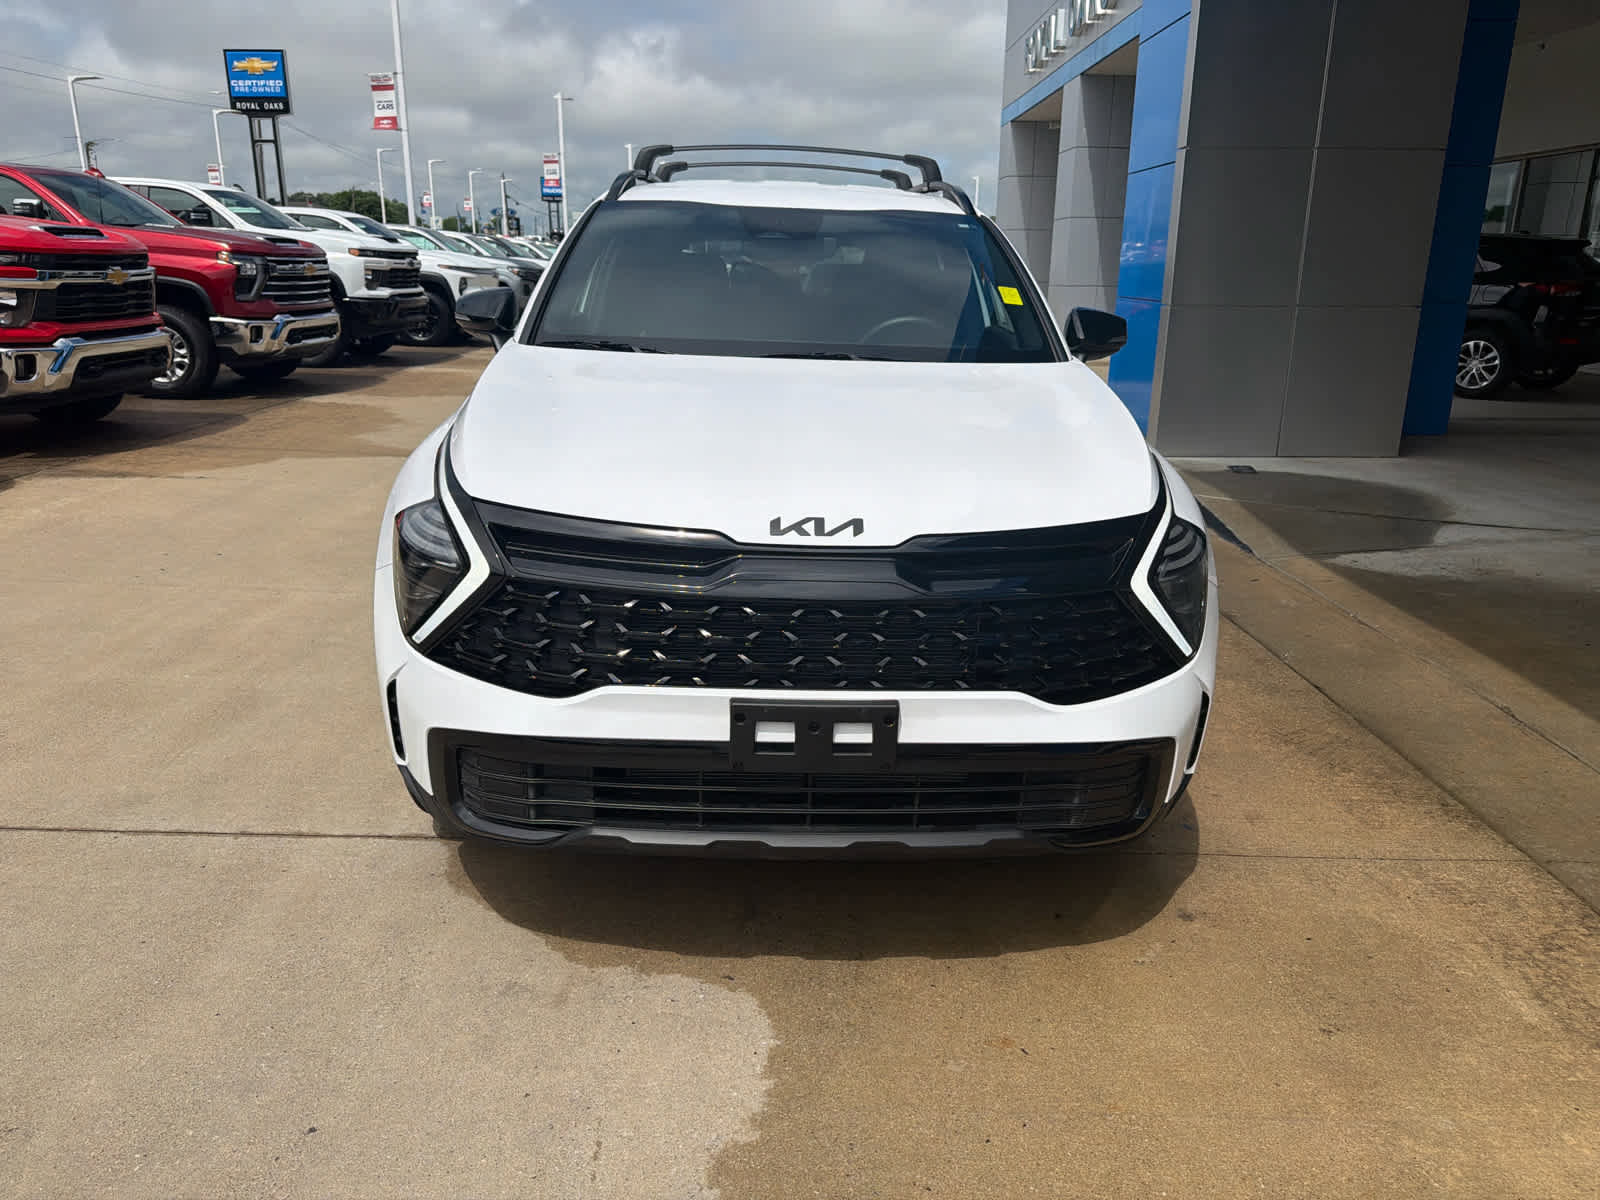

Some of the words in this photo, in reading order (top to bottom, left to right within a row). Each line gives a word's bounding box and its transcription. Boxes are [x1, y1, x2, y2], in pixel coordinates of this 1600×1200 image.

[231, 79, 283, 87] CERTIFIED
[236, 101, 260, 110] ROYAL
[263, 101, 284, 110] OAKS
[376, 103, 394, 111] CARS
[769, 516, 864, 537] KIA
